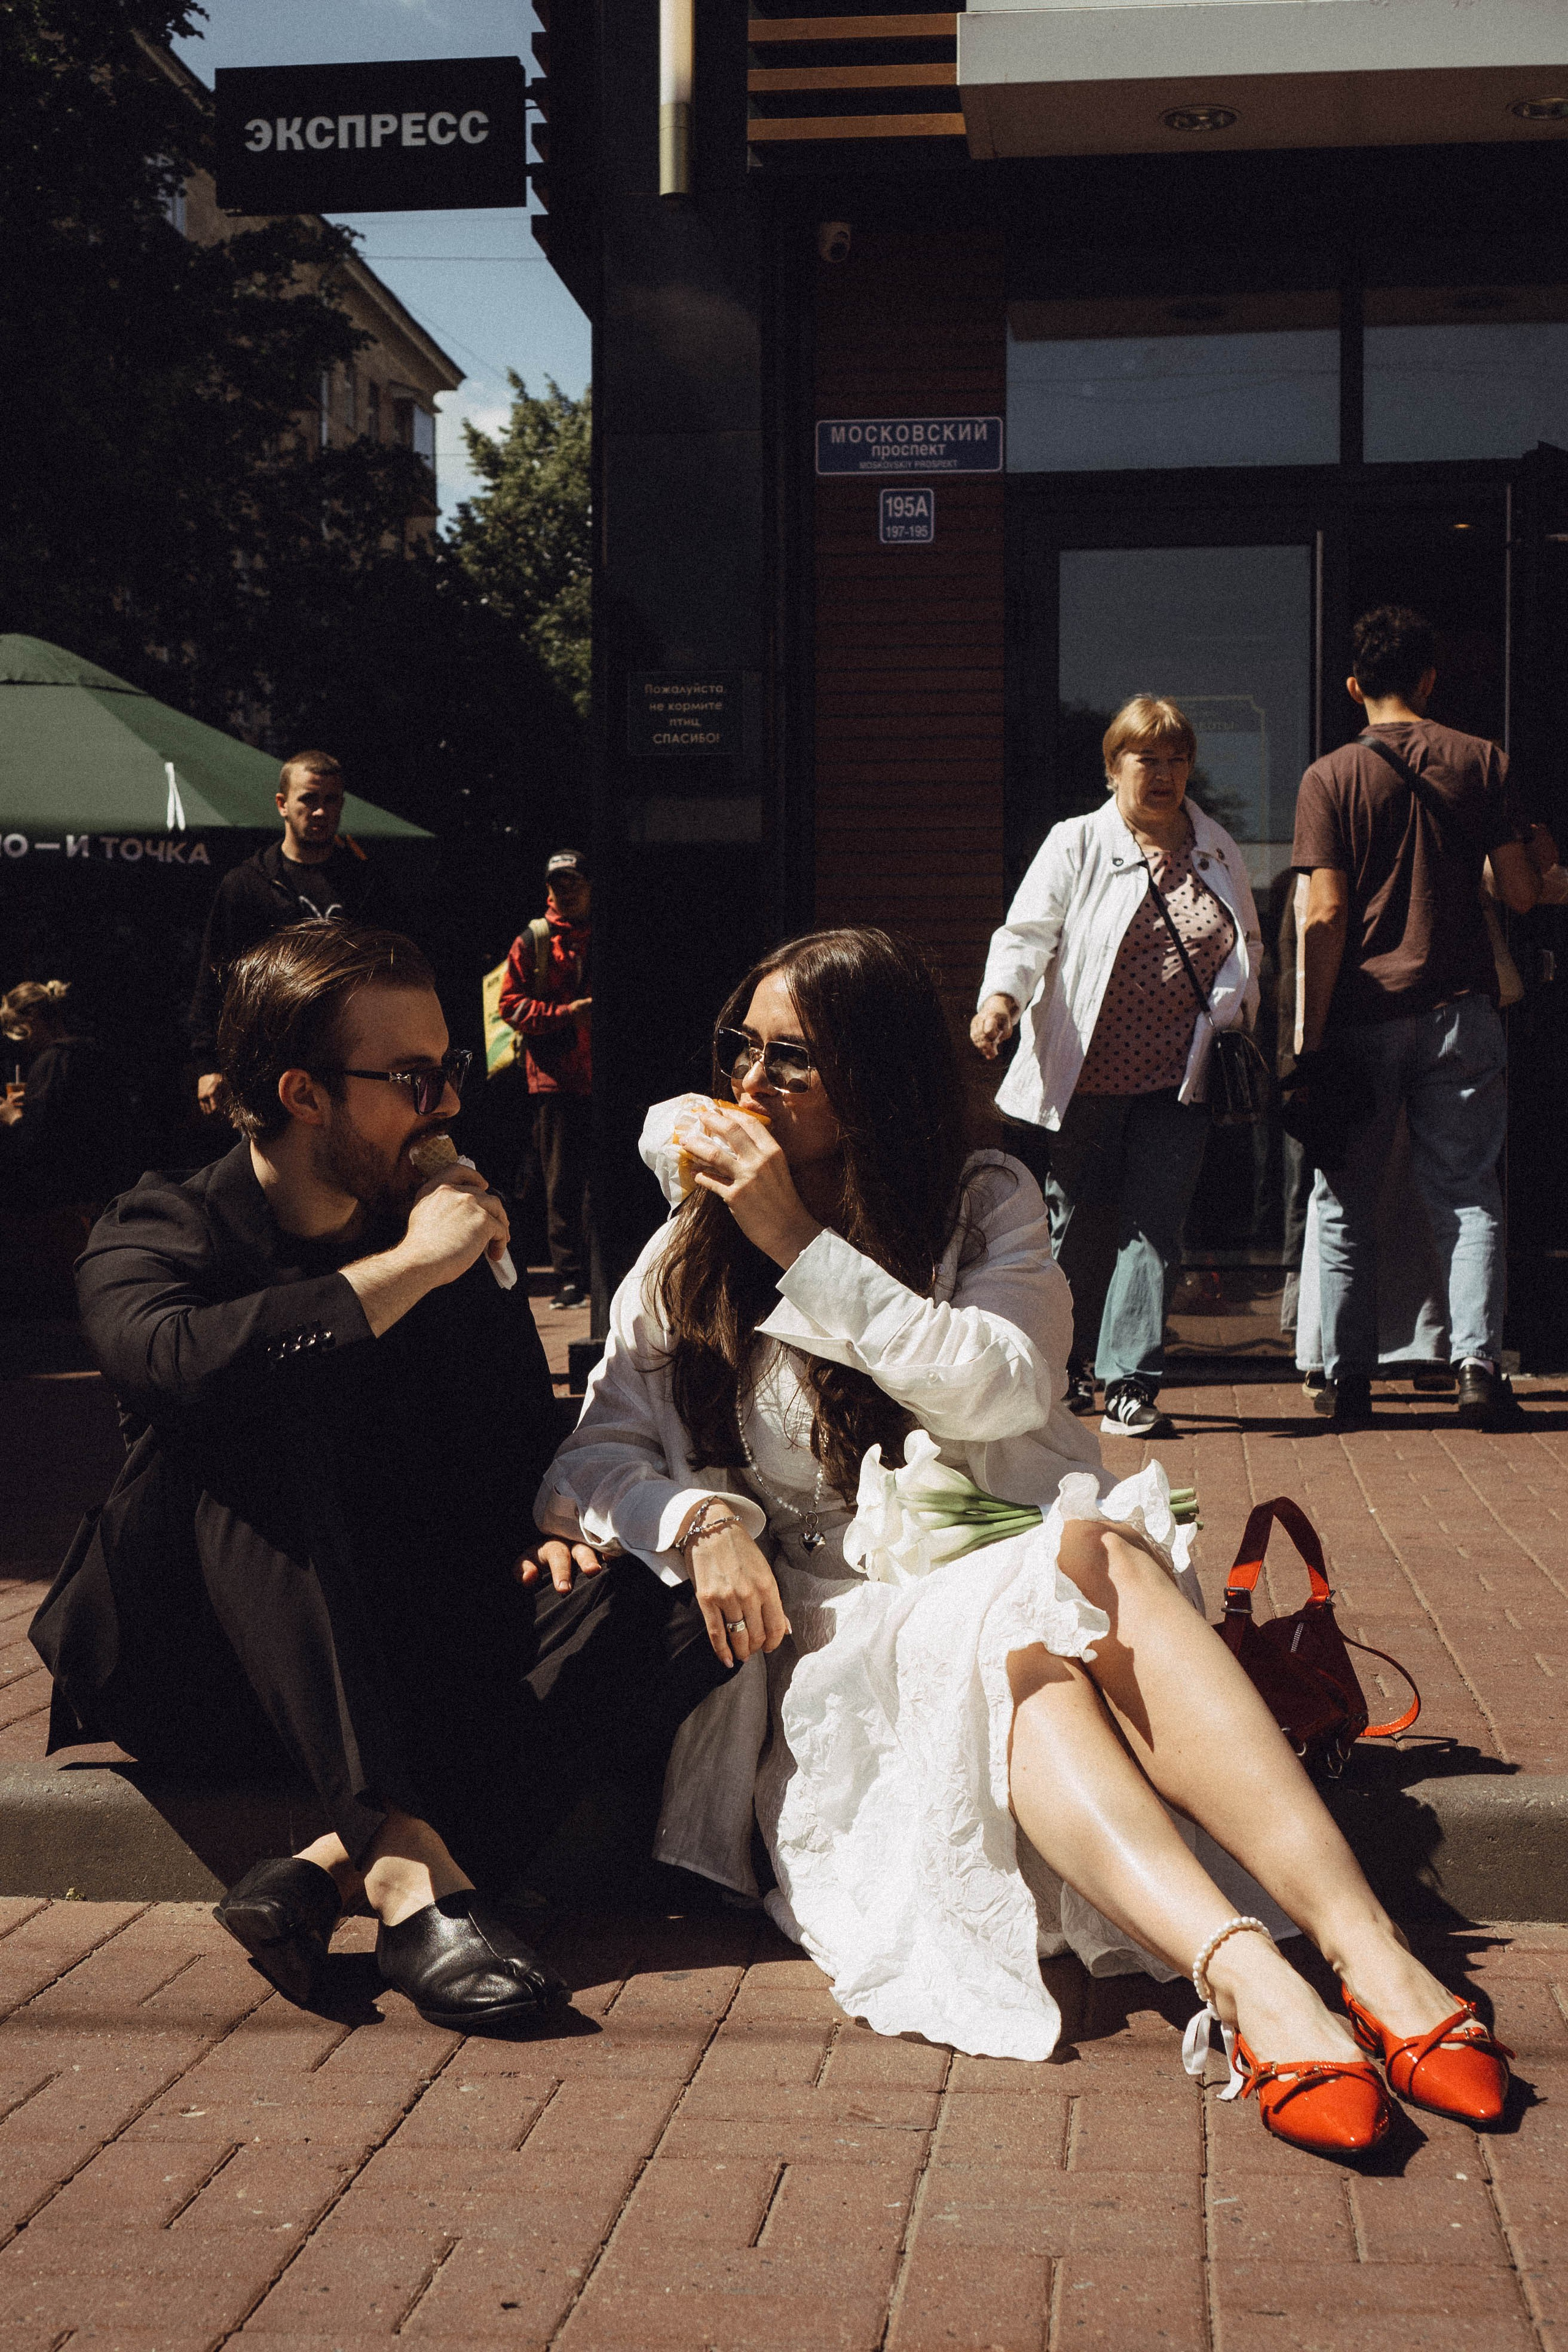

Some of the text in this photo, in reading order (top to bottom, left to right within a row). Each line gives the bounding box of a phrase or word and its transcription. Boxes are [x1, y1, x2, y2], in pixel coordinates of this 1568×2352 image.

[244, 110, 489, 152] ЭКСПРЕСС
[831, 421, 988, 443] МОСКОВСКИЙ
[871, 443, 946, 459] проспект
[914, 459, 958, 469] PROSPEKT
[885, 496, 929, 518] 195А
[885, 525, 929, 538] 197-195
[649, 702, 723, 712] не кормите
[652, 732, 720, 744] СПАСИБО!
[0, 833, 29, 858] О
[99, 837, 211, 865] ТОЧКА
